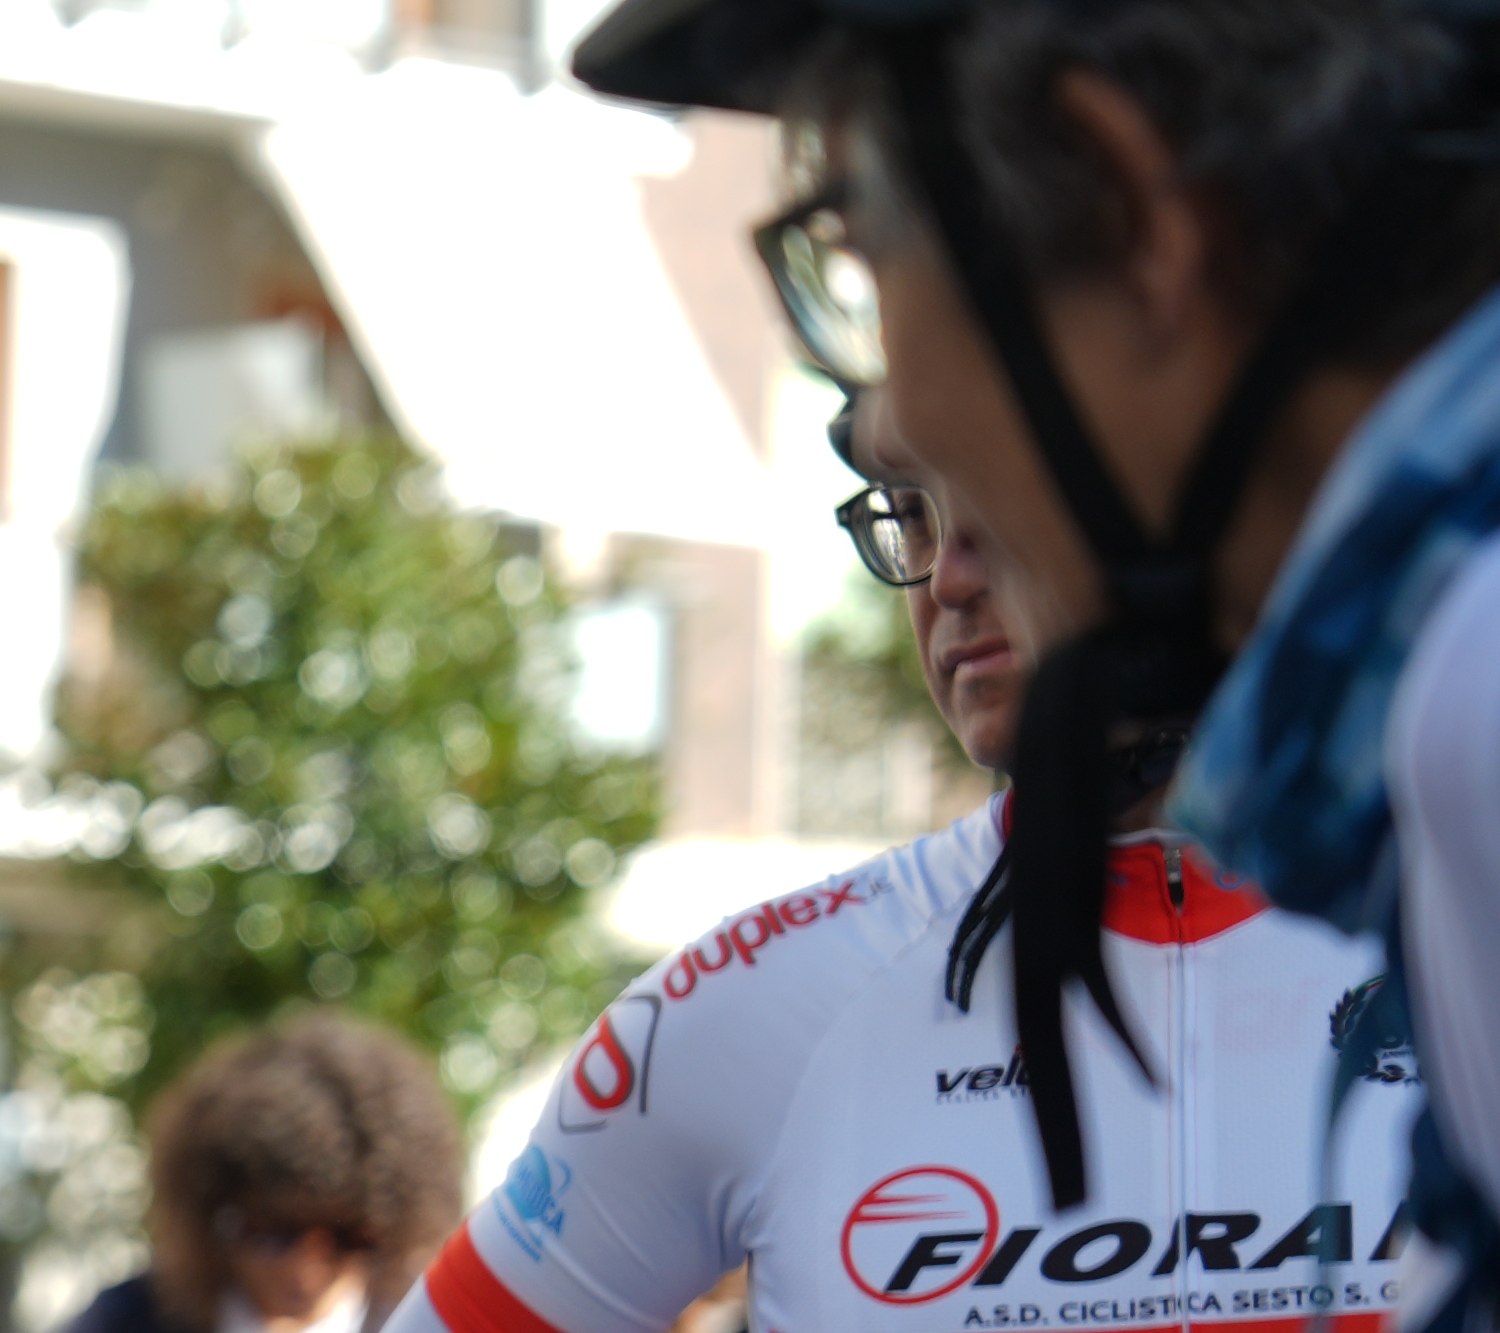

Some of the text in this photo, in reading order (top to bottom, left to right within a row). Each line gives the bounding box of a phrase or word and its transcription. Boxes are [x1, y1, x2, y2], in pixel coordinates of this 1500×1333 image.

[964, 1302, 1050, 1328] A.S.D.
[1058, 1291, 1222, 1324] CICLISTICA
[1232, 1285, 1334, 1313] SESTO
[1344, 1282, 1370, 1305] S.
